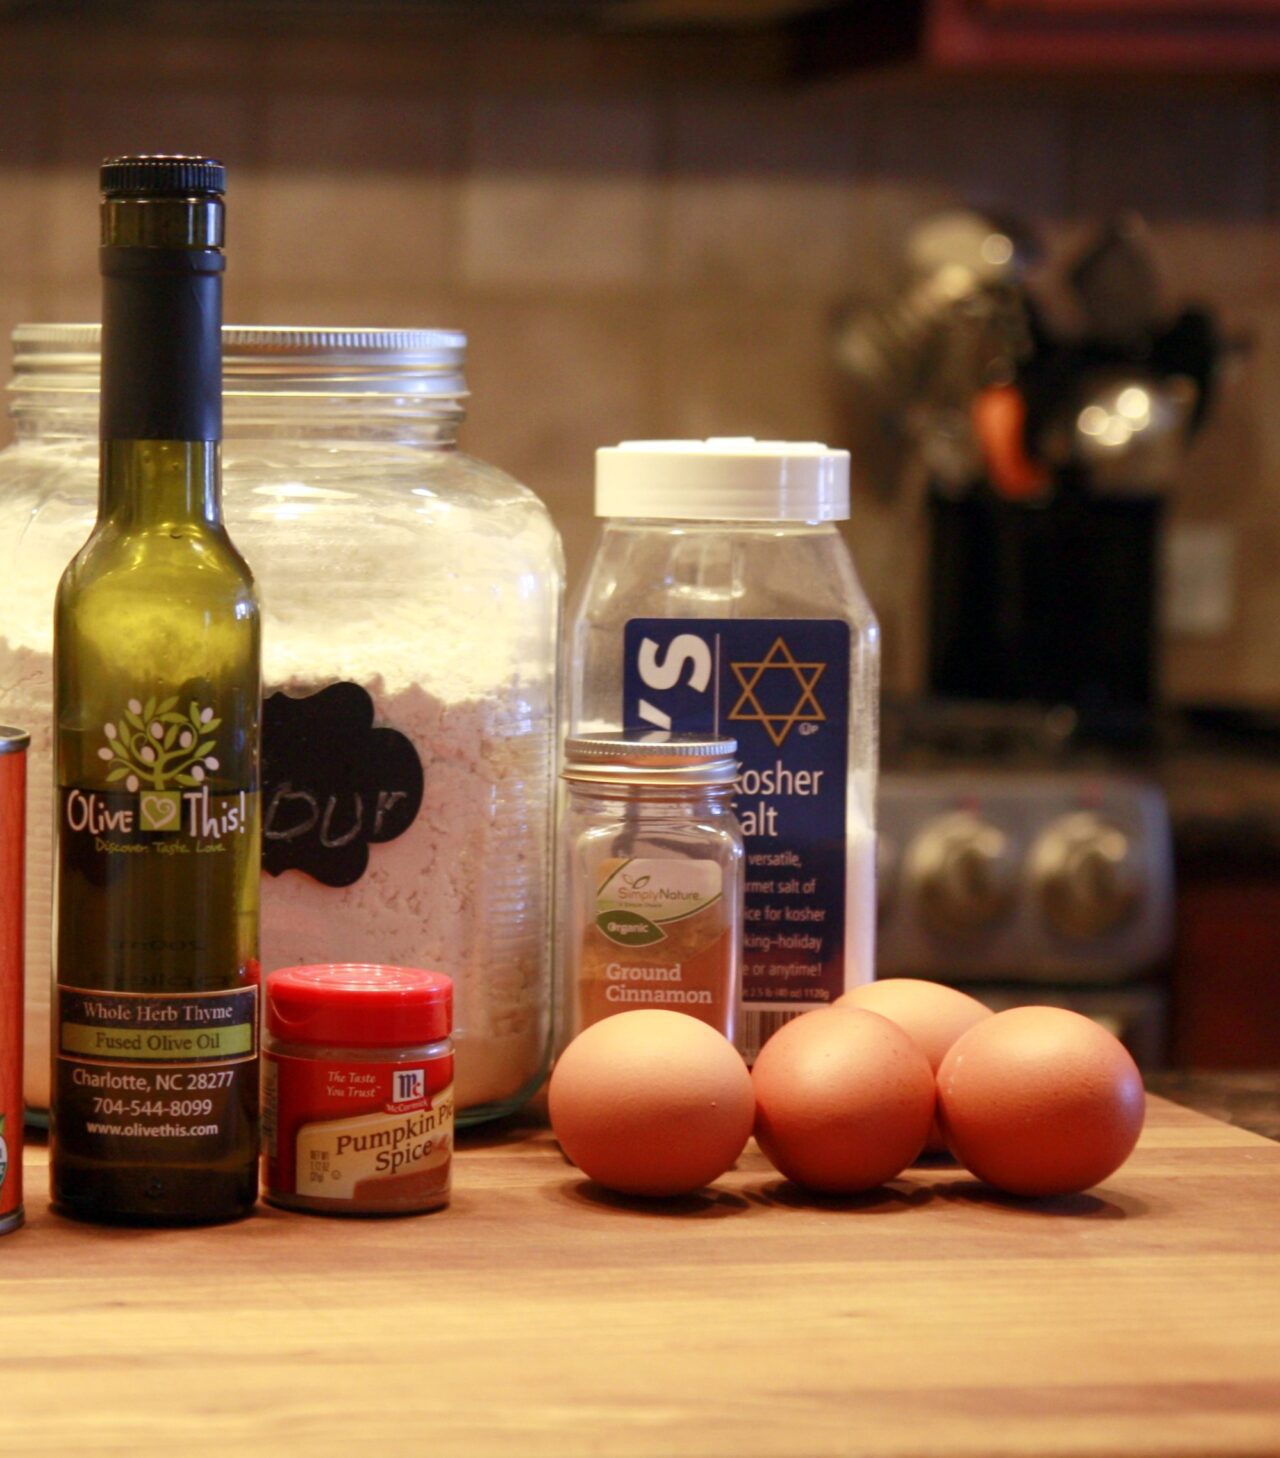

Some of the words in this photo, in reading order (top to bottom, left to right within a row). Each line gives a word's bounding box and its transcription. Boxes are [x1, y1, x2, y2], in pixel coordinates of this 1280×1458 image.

[183, 785, 246, 839] This!
[262, 782, 408, 848] our
[731, 801, 778, 837] alt
[748, 851, 802, 868] versatile,
[777, 879, 801, 894] salt
[802, 878, 817, 894] of
[764, 905, 782, 921] for
[785, 905, 826, 922] kosher
[607, 921, 649, 936] Organic
[606, 963, 682, 982] Ground
[769, 963, 822, 981] anytime!
[606, 985, 713, 1004] Cinnamon
[83, 1002, 132, 1021] Whole
[137, 1005, 178, 1022] Herb
[183, 1004, 233, 1023] Thyme
[95, 1031, 142, 1050] Fused
[146, 1034, 193, 1051] Olive
[196, 1033, 221, 1049] Oil
[72, 1068, 151, 1093] Charlotte,
[155, 1074, 183, 1091] NC
[186, 1070, 235, 1090] 28277
[328, 1071, 347, 1083] The
[349, 1072, 376, 1083] Taste
[326, 1085, 345, 1097] You
[92, 1097, 213, 1117] 704-544-8099
[86, 1122, 219, 1137] www.olivethis.com
[336, 1114, 435, 1156] Pumpkin
[375, 1140, 433, 1175] Spice
